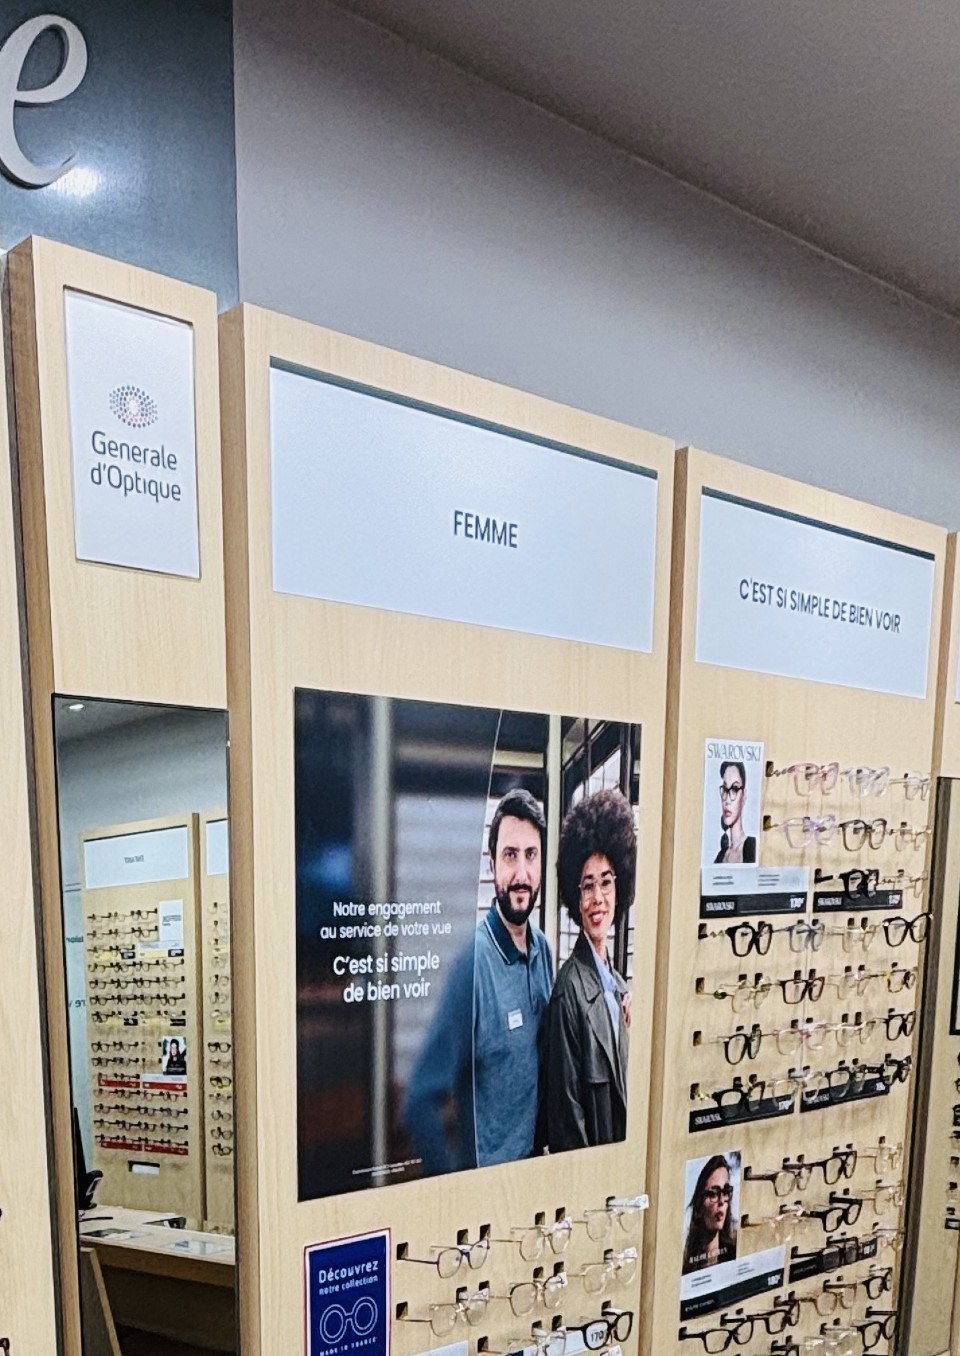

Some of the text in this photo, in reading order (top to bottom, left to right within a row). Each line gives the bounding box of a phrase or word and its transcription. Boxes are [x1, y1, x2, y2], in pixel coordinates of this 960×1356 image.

[91, 430, 177, 470] Generale
[90, 461, 181, 503] d'Optique
[453, 509, 518, 549] FEMME
[740, 577, 901, 633] C'EST SI SIMPLE DE BIEN VOIR
[707, 742, 761, 762] SWAROVSKI
[333, 900, 442, 920] Notre engagement
[320, 921, 452, 939] au service de votre vue
[333, 950, 440, 976] C'est si simple
[343, 977, 431, 1003] de bien voir
[319, 1260, 379, 1284] Découvrez
[319, 1274, 378, 1296] notre collection
[591, 1330, 606, 1342] 170
